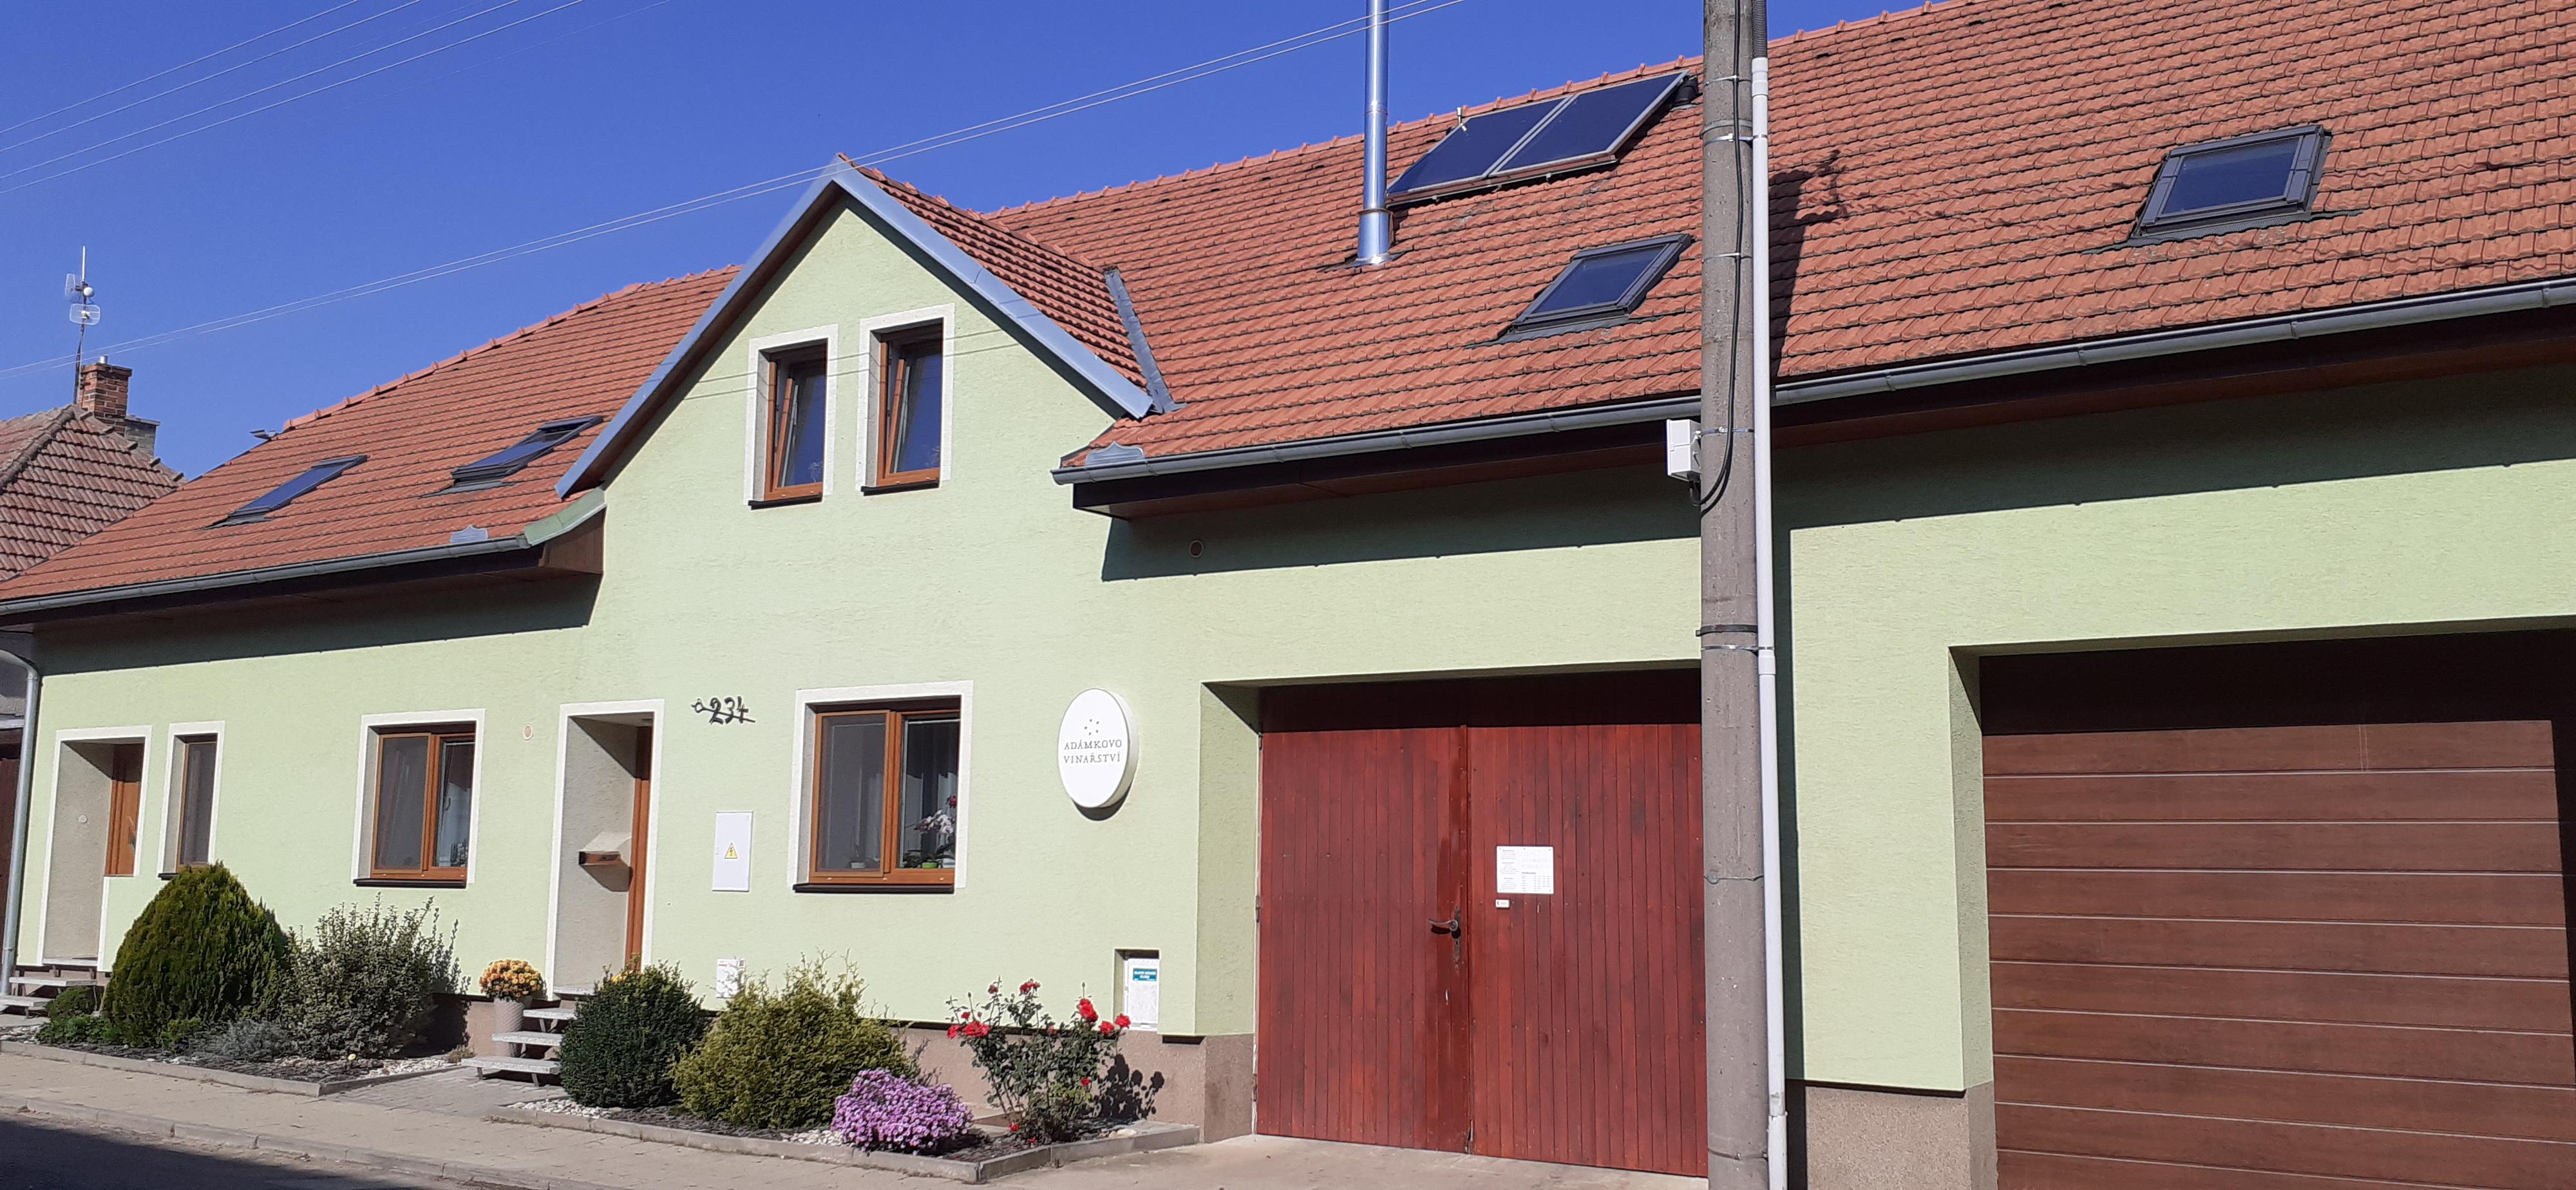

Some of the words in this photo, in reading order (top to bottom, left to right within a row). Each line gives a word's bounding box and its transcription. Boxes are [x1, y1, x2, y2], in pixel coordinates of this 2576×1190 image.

[709, 696, 748, 724] 234
[1064, 739, 1122, 750] ADÁMKOVO
[1063, 751, 1121, 764] VINAŘSTVÍ
